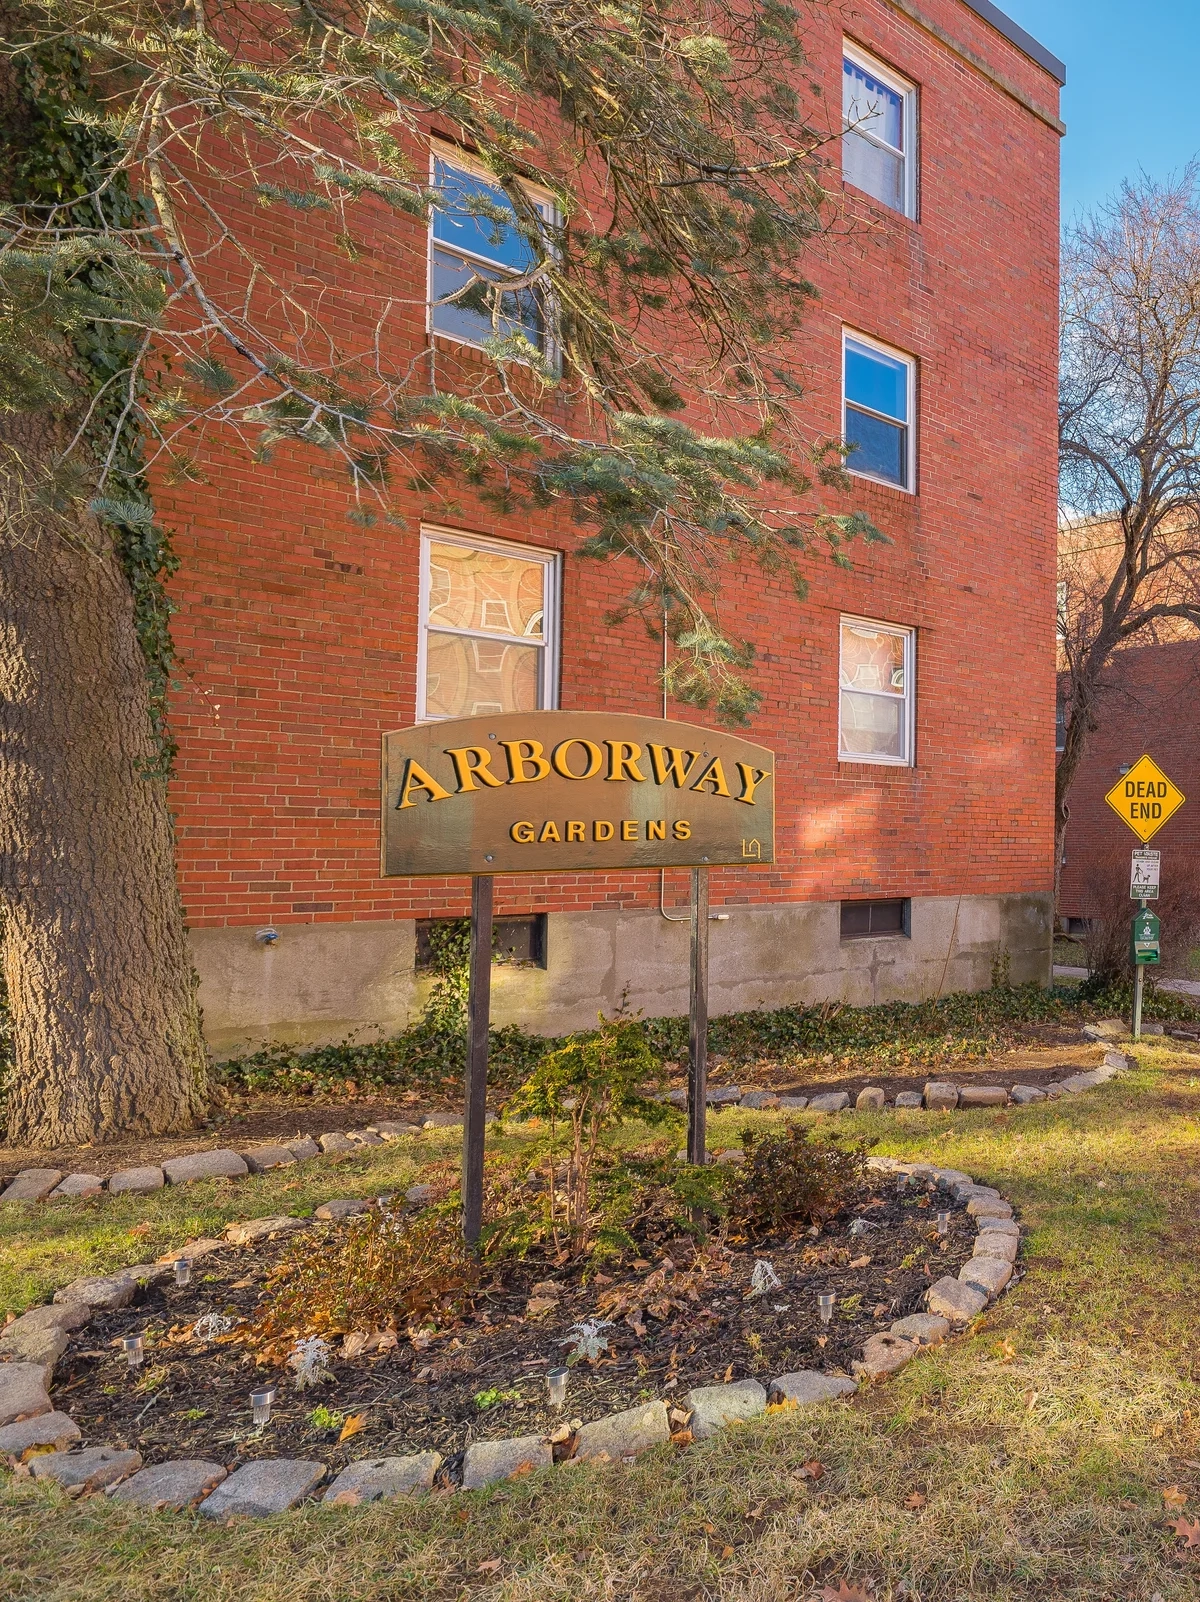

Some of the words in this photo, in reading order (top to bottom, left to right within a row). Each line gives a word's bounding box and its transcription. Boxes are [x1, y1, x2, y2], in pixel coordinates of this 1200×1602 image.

[396, 738, 771, 810] ARBORWAY
[1125, 781, 1167, 798] DEAD
[1130, 802, 1162, 819] END
[509, 820, 692, 844] GARDENS
